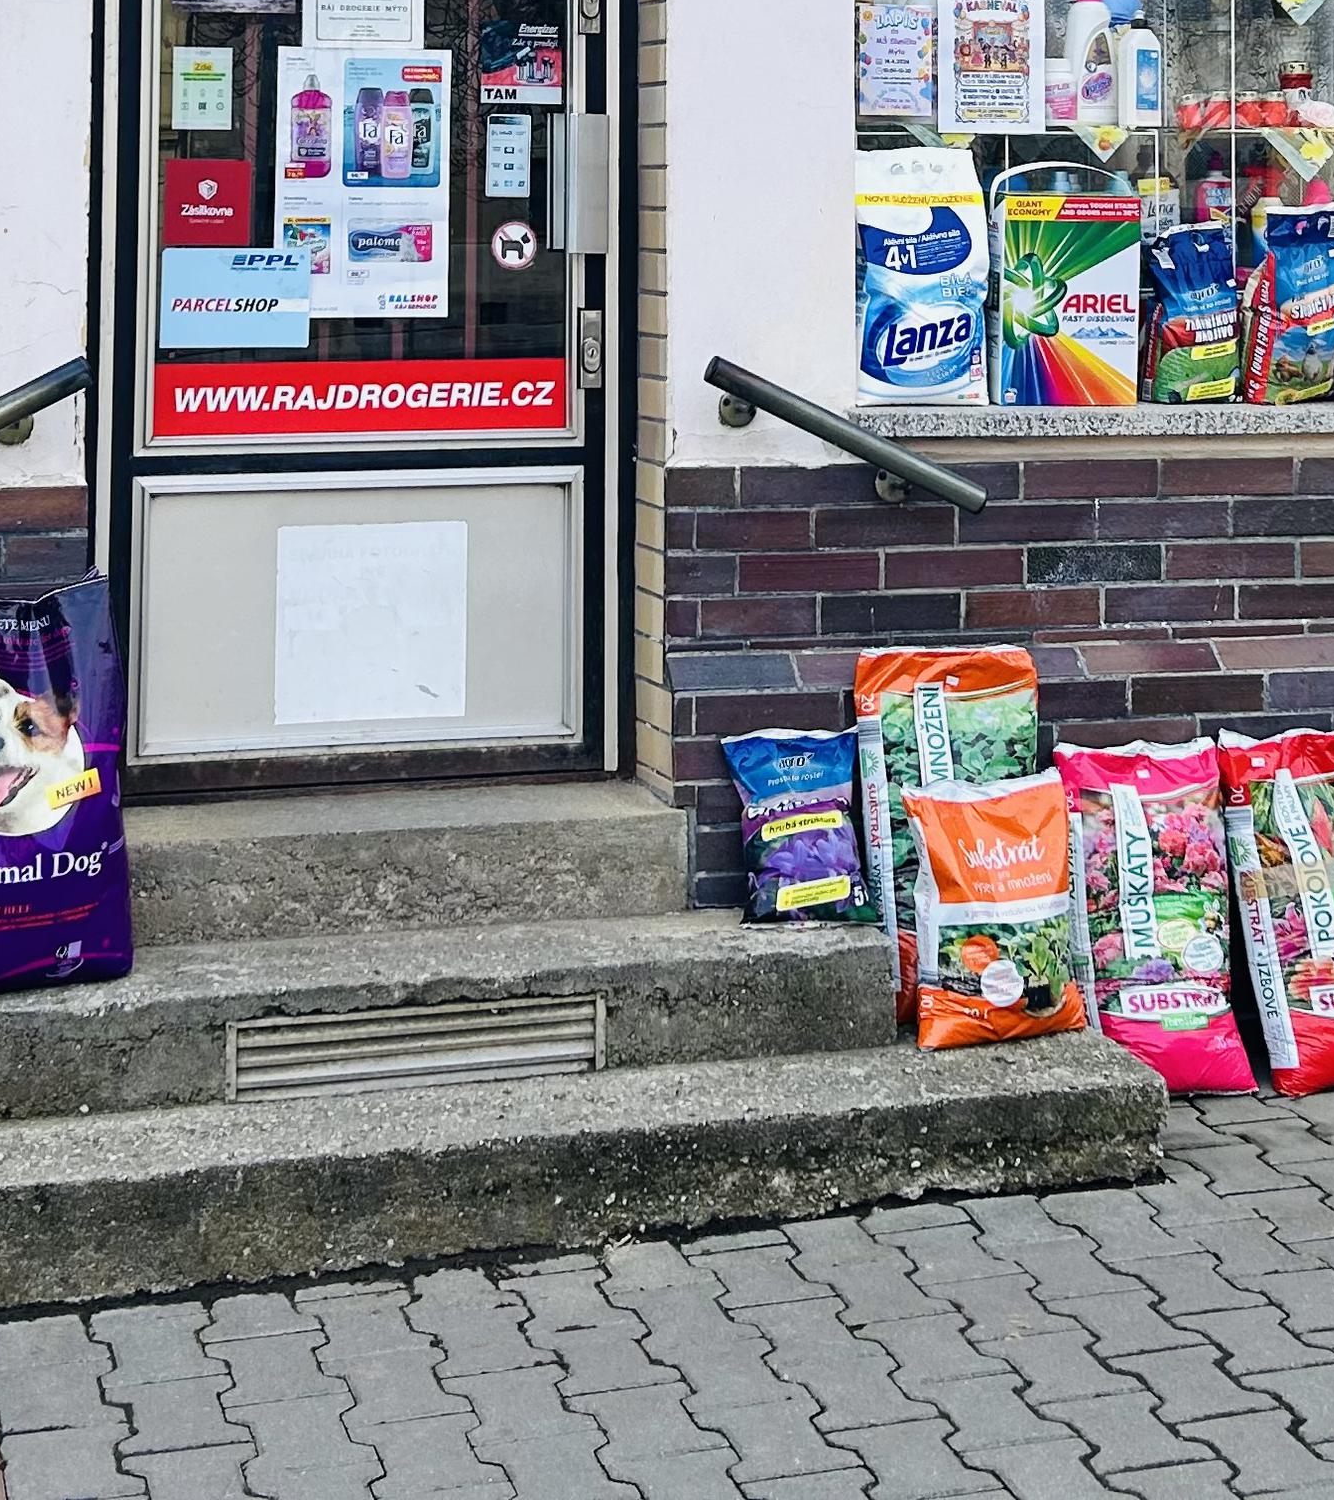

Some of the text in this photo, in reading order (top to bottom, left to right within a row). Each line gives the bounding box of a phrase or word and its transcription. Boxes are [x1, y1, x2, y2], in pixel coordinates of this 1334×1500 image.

[967, 0, 1018, 12] KARNEVAL
[519, 23, 558, 35] Energizer
[484, 88, 517, 100] TAM
[389, 130, 404, 144] Fa
[181, 204, 233, 216] Zásilkovna
[247, 255, 299, 266] PPL
[171, 298, 279, 312] PARCELSHOP
[1062, 294, 1135, 313] ARIEL
[883, 313, 971, 366] Lanza
[174, 381, 556, 414] WWW.RAJDROGERIE.CZ
[20, 616, 50, 631] MENU
[769, 819, 796, 833] hrubá
[958, 835, 1045, 869] Substrát
[50, 851, 102, 878] Dog
[1120, 831, 1156, 949] MUŠKÁTY
